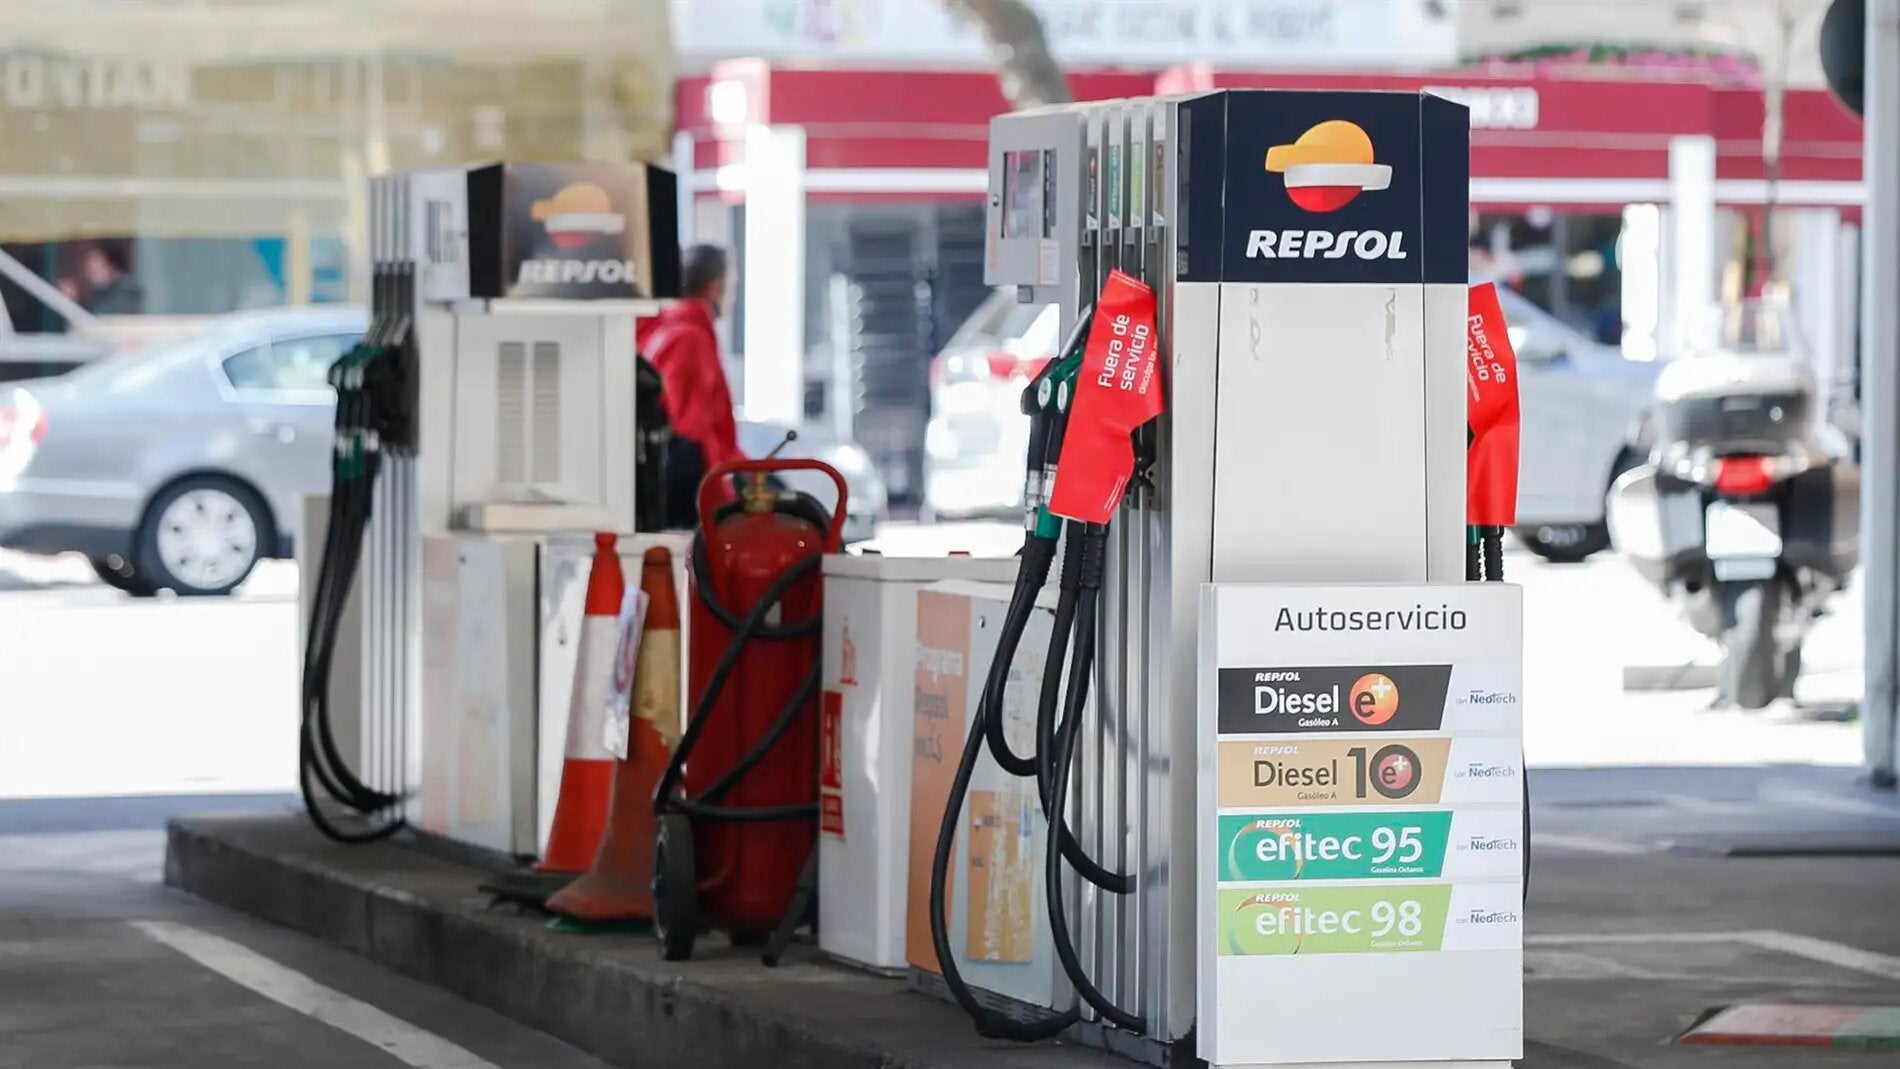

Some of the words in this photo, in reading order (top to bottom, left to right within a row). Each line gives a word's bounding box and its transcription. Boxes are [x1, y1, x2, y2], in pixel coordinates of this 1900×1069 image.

[1246, 230, 1407, 260] REPSOL
[518, 259, 637, 284] REPSOL
[1098, 340, 1123, 388] Fuera
[1111, 314, 1130, 336] de
[1120, 324, 1149, 391] servicio
[1468, 314, 1495, 360] Fuera
[1491, 362, 1506, 384] de
[1275, 604, 1467, 632] Autoservicio
[1255, 672, 1300, 682] REPSOL
[1255, 685, 1339, 715] Diesel
[1470, 692, 1516, 704] NeoTech
[1298, 718, 1330, 727] Gasóleo
[1331, 717, 1339, 726] A
[1254, 745, 1299, 755] REPSOL
[1254, 759, 1337, 787] Diesel
[1347, 744, 1422, 799] 10
[1297, 791, 1329, 800] Gasóleo
[1256, 819, 1302, 829] REPSOL
[1256, 833, 1362, 861] efitec
[1371, 827, 1422, 863] 95
[1255, 893, 1300, 903] REPSOL
[1256, 907, 1362, 935] efitec
[1371, 900, 1422, 937] 98
